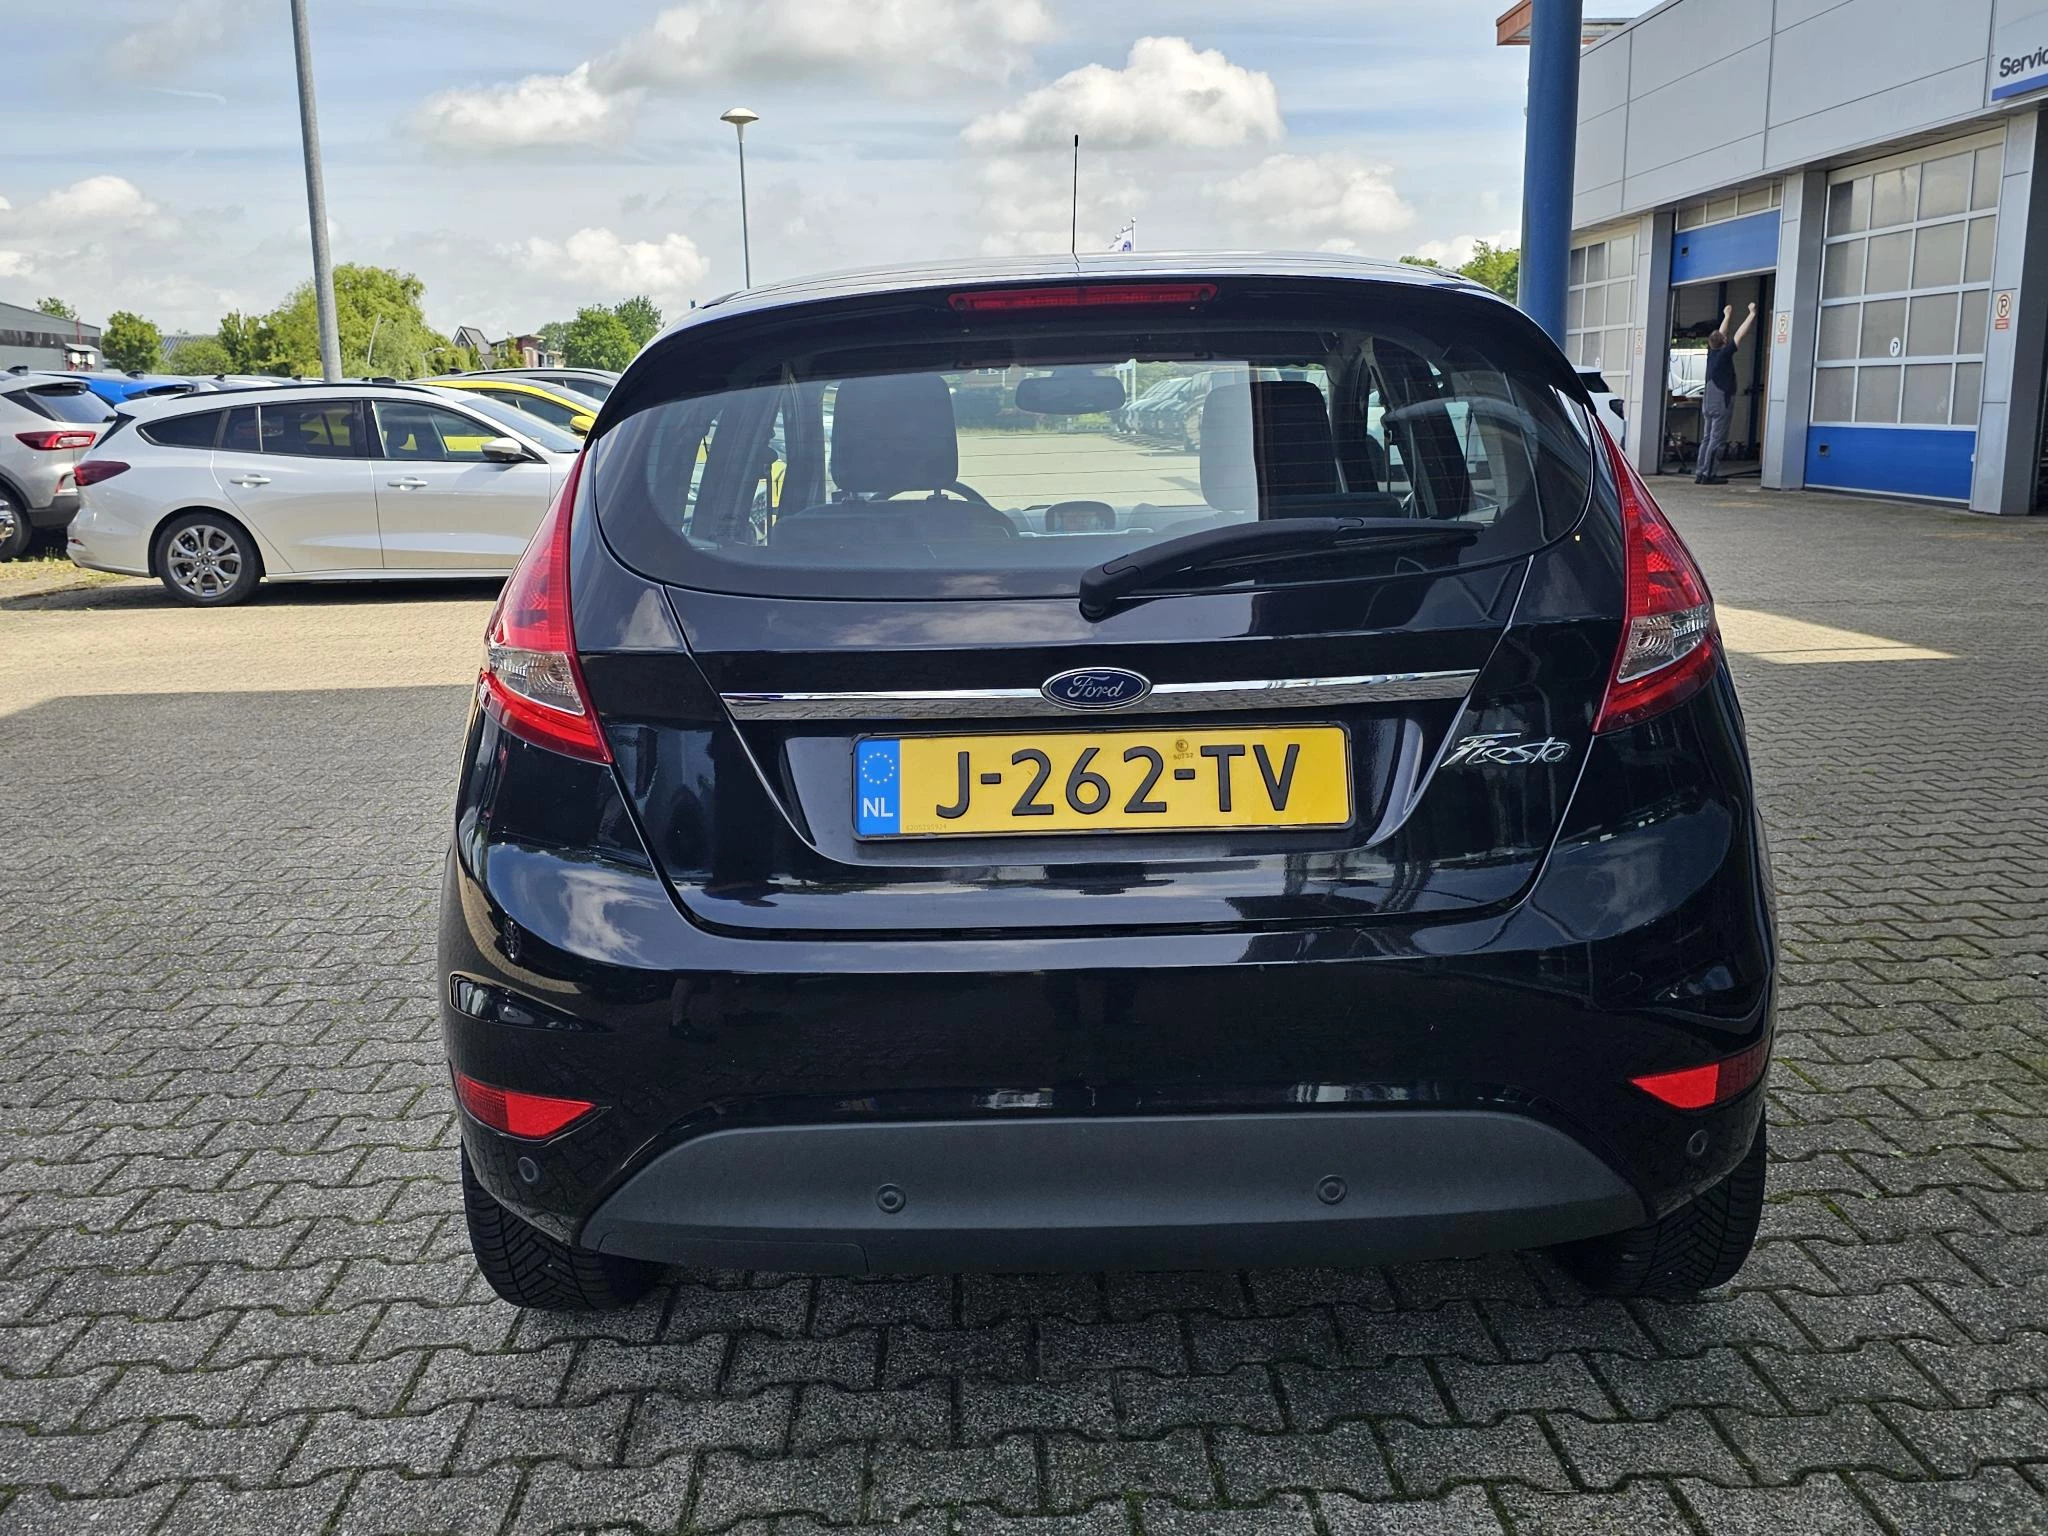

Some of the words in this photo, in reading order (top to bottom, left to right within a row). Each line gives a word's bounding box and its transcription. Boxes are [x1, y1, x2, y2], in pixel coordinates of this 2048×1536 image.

[1066, 675, 1125, 698] Ford
[1440, 732, 1571, 767] Fiesta
[936, 743, 1301, 819] J-262-TV
[863, 797, 894, 818] NL
